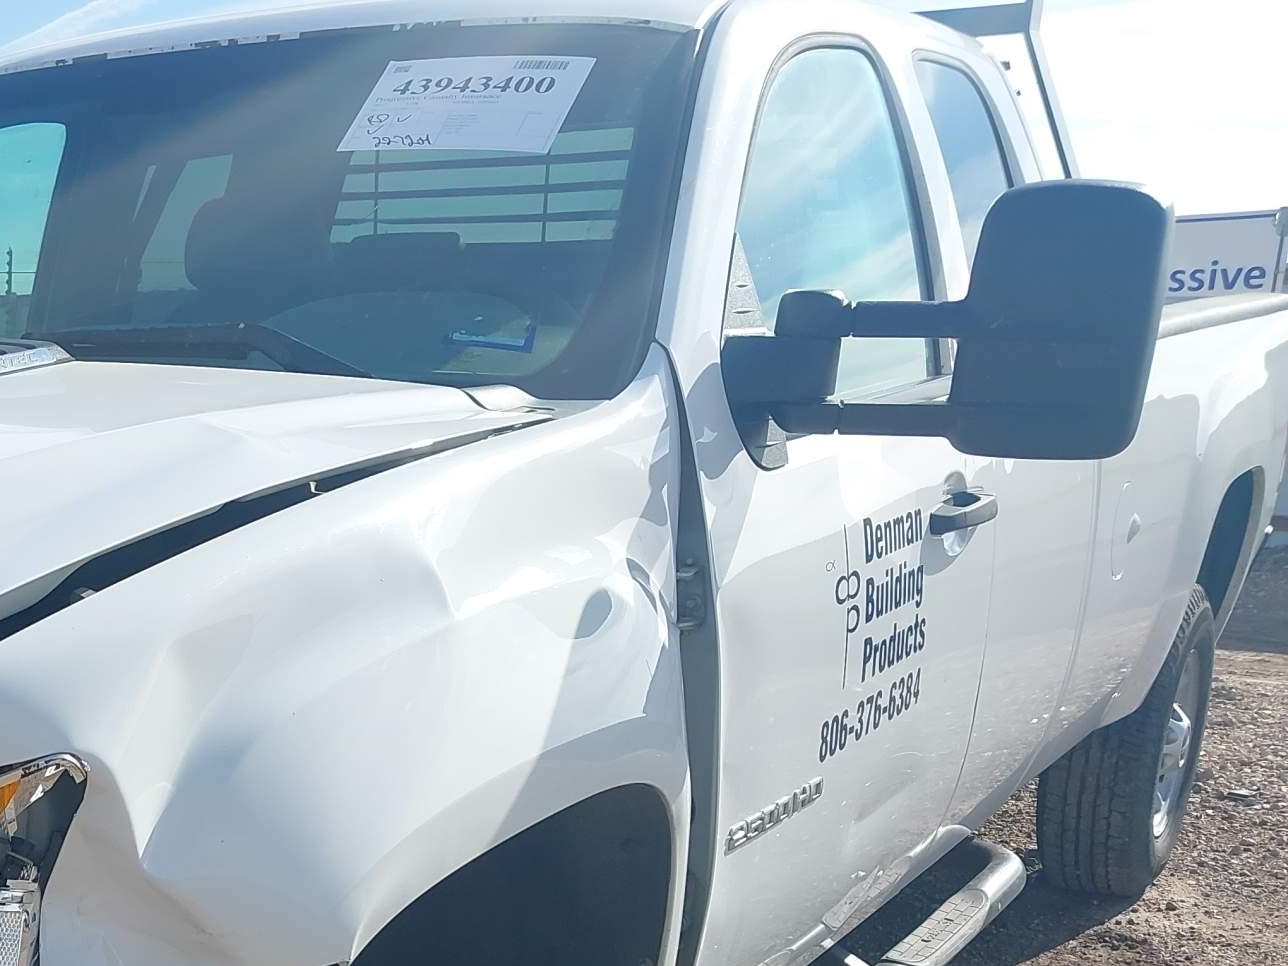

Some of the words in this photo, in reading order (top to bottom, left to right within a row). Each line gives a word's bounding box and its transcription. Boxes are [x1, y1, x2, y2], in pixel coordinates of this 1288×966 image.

[393, 75, 556, 95] 43943400
[863, 506, 923, 564] Denman
[865, 561, 924, 624] Building
[862, 613, 926, 682] Products
[819, 667, 921, 763] 806-376-6384
[724, 776, 824, 856] 2500HD
